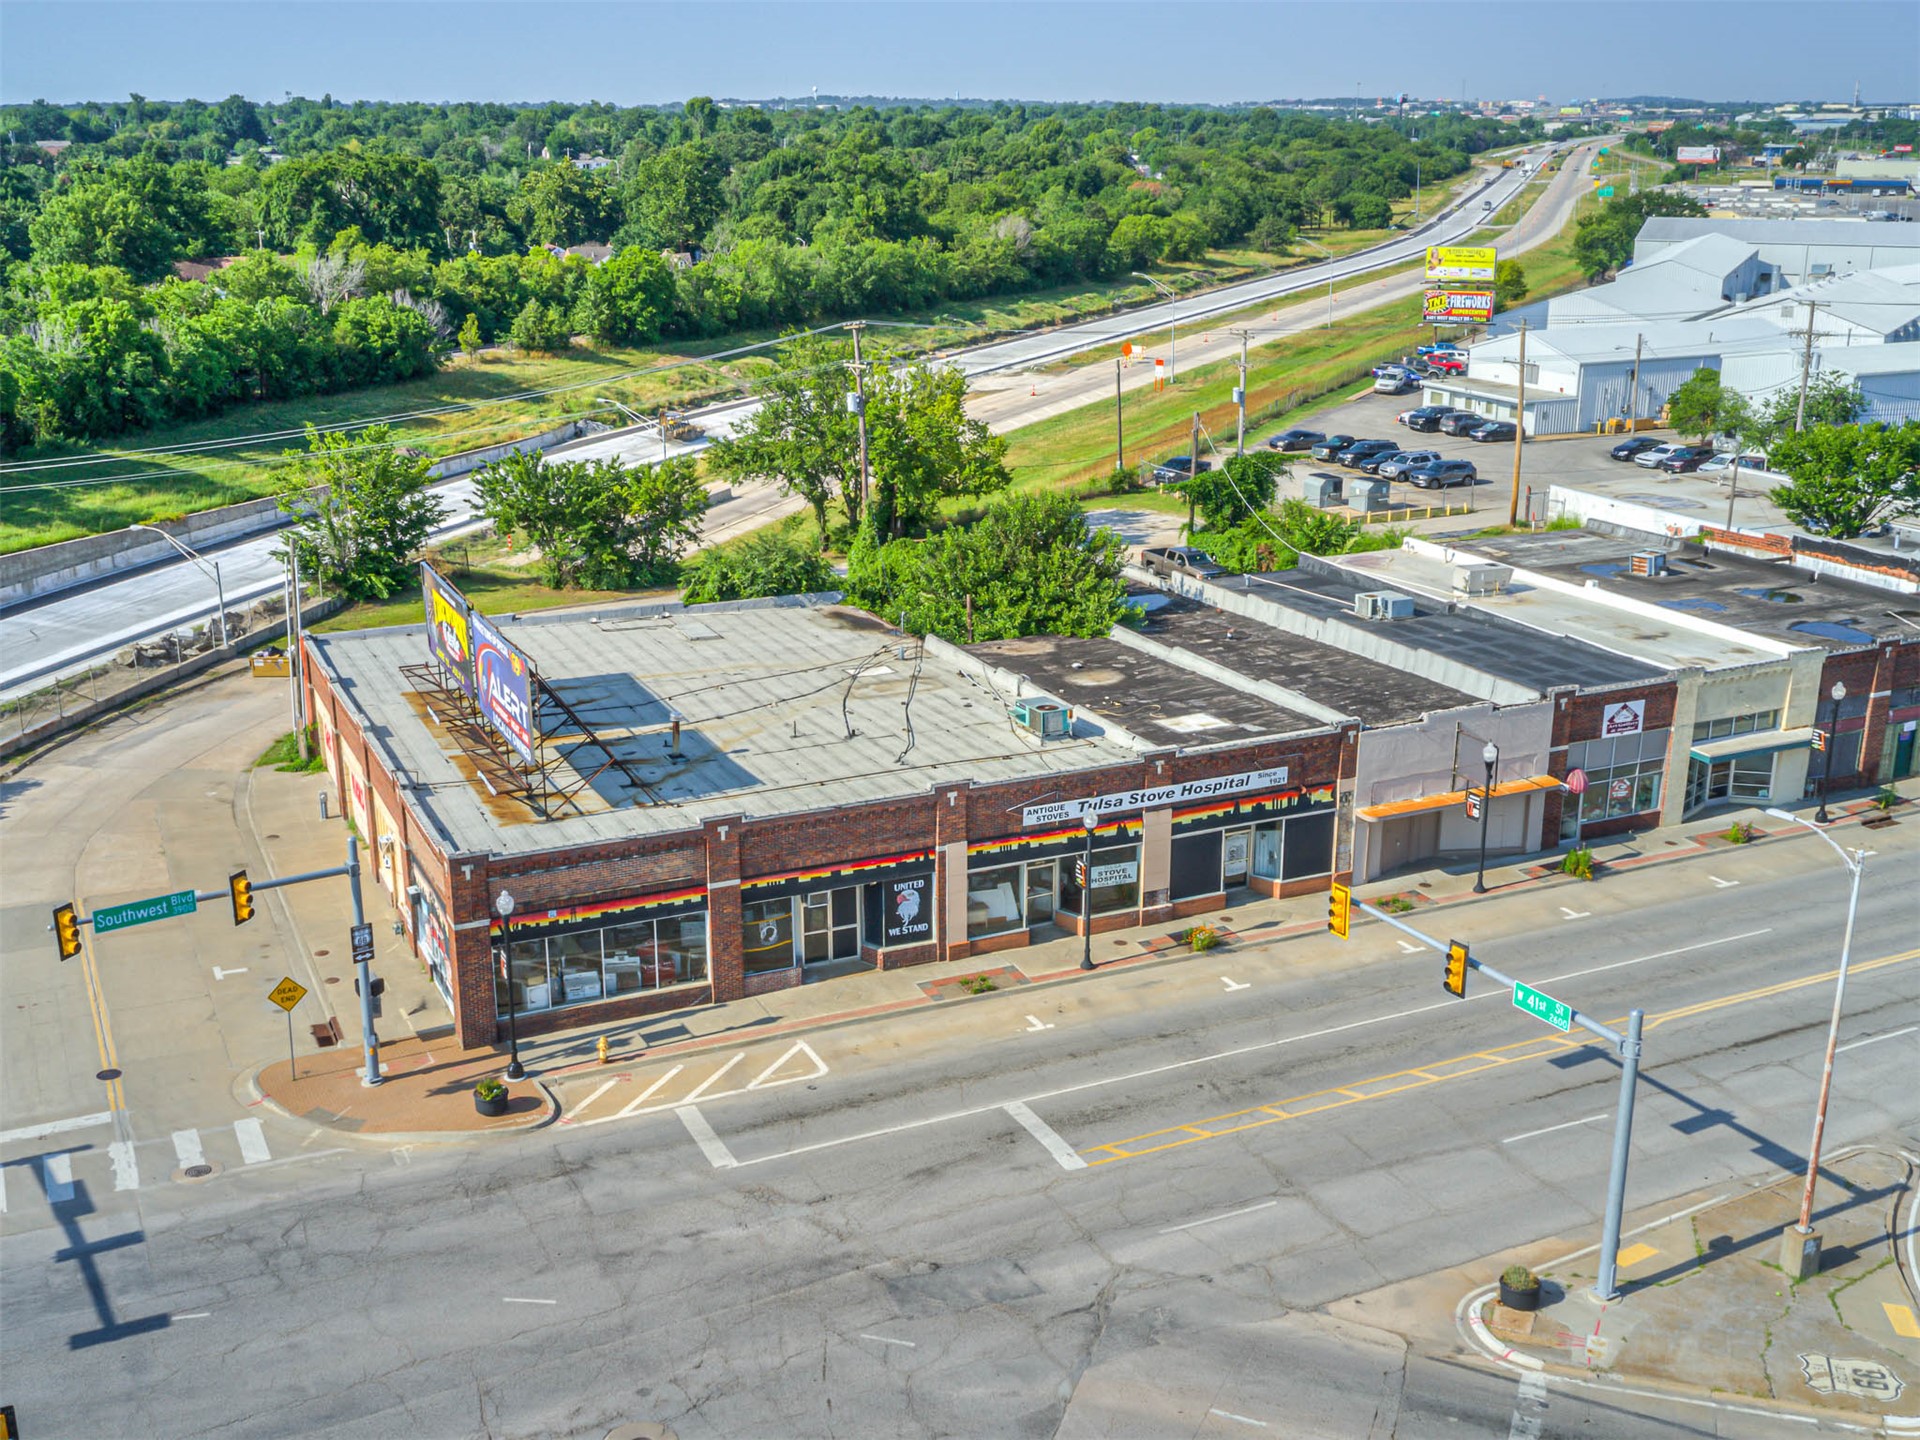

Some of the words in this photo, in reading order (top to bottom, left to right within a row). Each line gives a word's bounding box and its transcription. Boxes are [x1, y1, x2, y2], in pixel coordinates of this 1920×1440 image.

[1428, 294, 1446, 308] TNT
[1450, 294, 1490, 309] FIREWORKS
[488, 672, 528, 730] ALERT
[512, 734, 531, 761] OWNED
[1258, 771, 1278, 779] Since
[1270, 777, 1286, 785] 1921
[1077, 798, 1123, 813] Tulsa
[1129, 790, 1176, 805] Stove
[1180, 775, 1251, 797] Hospital
[1026, 804, 1066, 816] ANTIQUE
[1036, 811, 1070, 822] STOVES
[1091, 873, 1133, 883] HOSPITAL
[1098, 867, 1128, 877] STOVE
[894, 879, 924, 891] UNITED
[97, 902, 168, 928] Southwest
[171, 892, 193, 906] Blvd
[173, 904, 194, 914] 3900
[889, 928, 901, 936] WE
[902, 923, 929, 934] STAND
[277, 986, 298, 995] DEAD
[281, 995, 296, 1003] END
[1527, 995, 1547, 1012] 41st
[1555, 1003, 1564, 1016] St
[1549, 1013, 1568, 1029] 2600
[1852, 1368, 1889, 1390] 66
